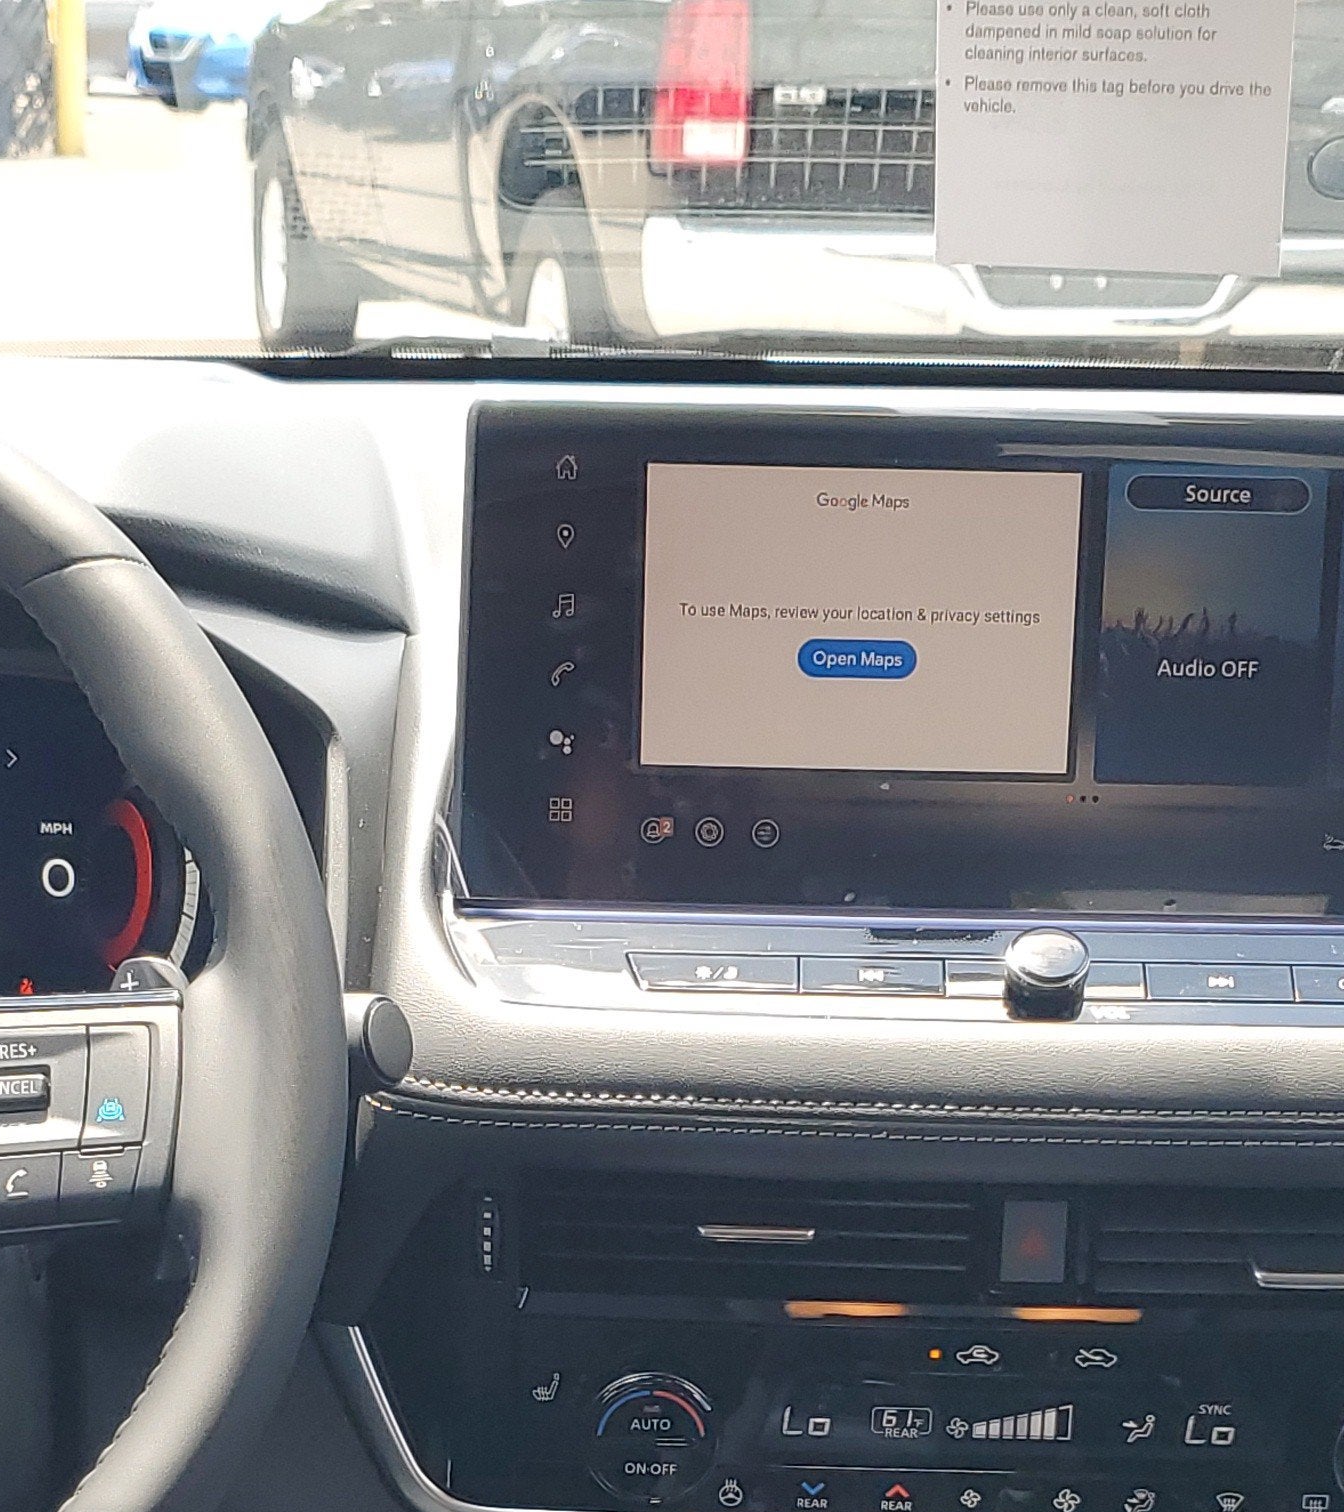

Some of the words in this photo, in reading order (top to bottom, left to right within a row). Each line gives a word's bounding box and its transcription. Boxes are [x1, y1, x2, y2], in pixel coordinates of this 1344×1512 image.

[966, 1, 1014, 16] Please
[1018, 4, 1044, 16] use
[1048, 1, 1077, 20] only
[1081, 6, 1090, 17] a
[1095, 3, 1137, 19] clean,
[1142, 3, 1169, 18] soft
[1174, 3, 1210, 18] cloth
[965, 22, 1041, 41] dampened
[1045, 25, 1057, 39] in
[1062, 24, 1091, 39] mild
[1097, 28, 1131, 42] soap
[1136, 26, 1192, 41] solution
[1198, 26, 1218, 41] for
[964, 45, 1024, 64] cleaning
[1029, 46, 1077, 62] interior
[1082, 47, 1147, 62] surfaces.
[964, 75, 1012, 92] Please
[1016, 80, 1067, 93] remove
[1072, 77, 1097, 93] this
[1102, 79, 1124, 97] tag
[1129, 79, 1175, 94] before
[1180, 83, 1205, 98] you
[1210, 80, 1244, 96] drive
[1249, 81, 1272, 97] the
[964, 98, 1016, 113] vehicle.
[816, 492, 868, 512] Google
[871, 493, 910, 511] Maps
[1185, 484, 1252, 504] Source
[679, 602, 697, 617] To
[701, 604, 726, 617] use
[729, 603, 771, 621] Maps,
[775, 605, 819, 619] review
[823, 607, 853, 623] your
[857, 606, 913, 621] location
[917, 607, 926, 621] &
[930, 609, 980, 626] privacy
[984, 610, 1040, 626] settings
[813, 650, 856, 669] Open
[860, 651, 903, 670] Maps
[1156, 659, 1216, 678] Audio
[1220, 660, 1260, 679] OFF
[39, 821, 74, 836] MPH
[1198, 1404, 1232, 1416] SYNC
[630, 1418, 672, 1431] AUTO
[884, 1428, 919, 1439] REAR
[796, 1498, 829, 1509] REAR
[880, 1500, 913, 1511] REAR
